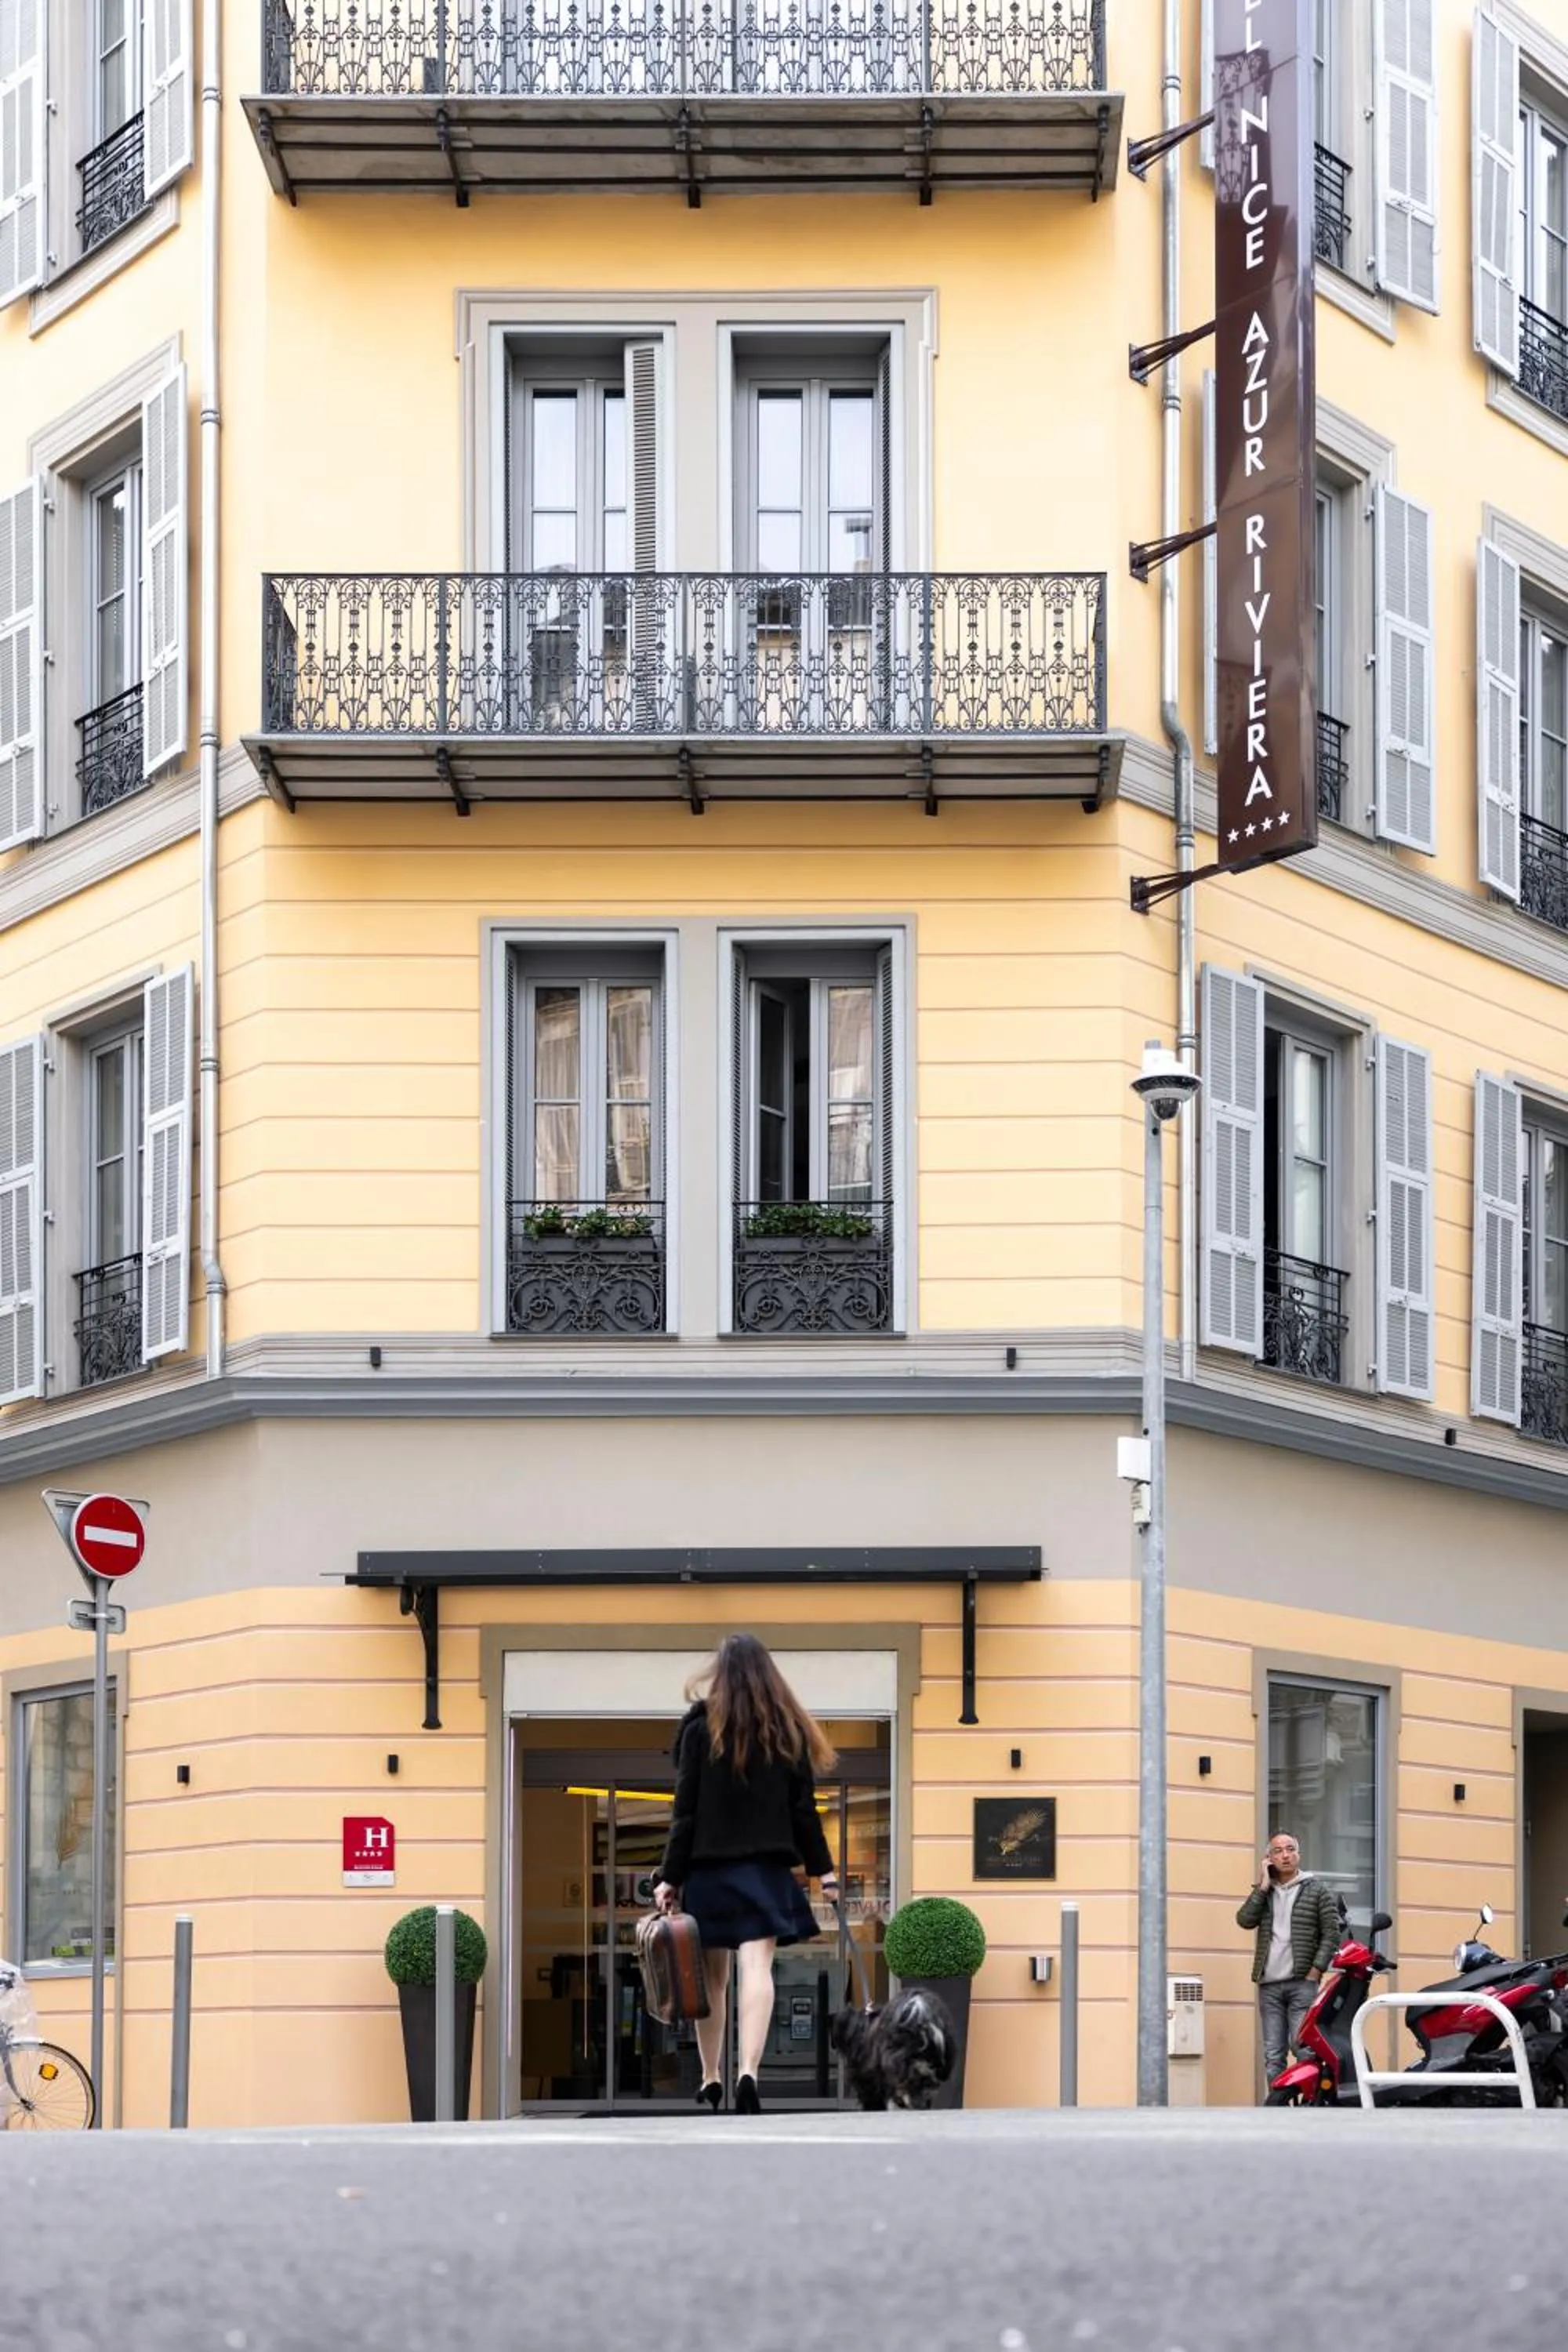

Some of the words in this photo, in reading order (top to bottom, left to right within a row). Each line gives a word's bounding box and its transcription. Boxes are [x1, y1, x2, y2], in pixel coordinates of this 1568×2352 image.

[1240, 96, 1268, 270] NICE
[1242, 311, 1269, 477] AZUR
[1245, 514, 1272, 807] RIVIERA
[364, 1826, 390, 1848] H
